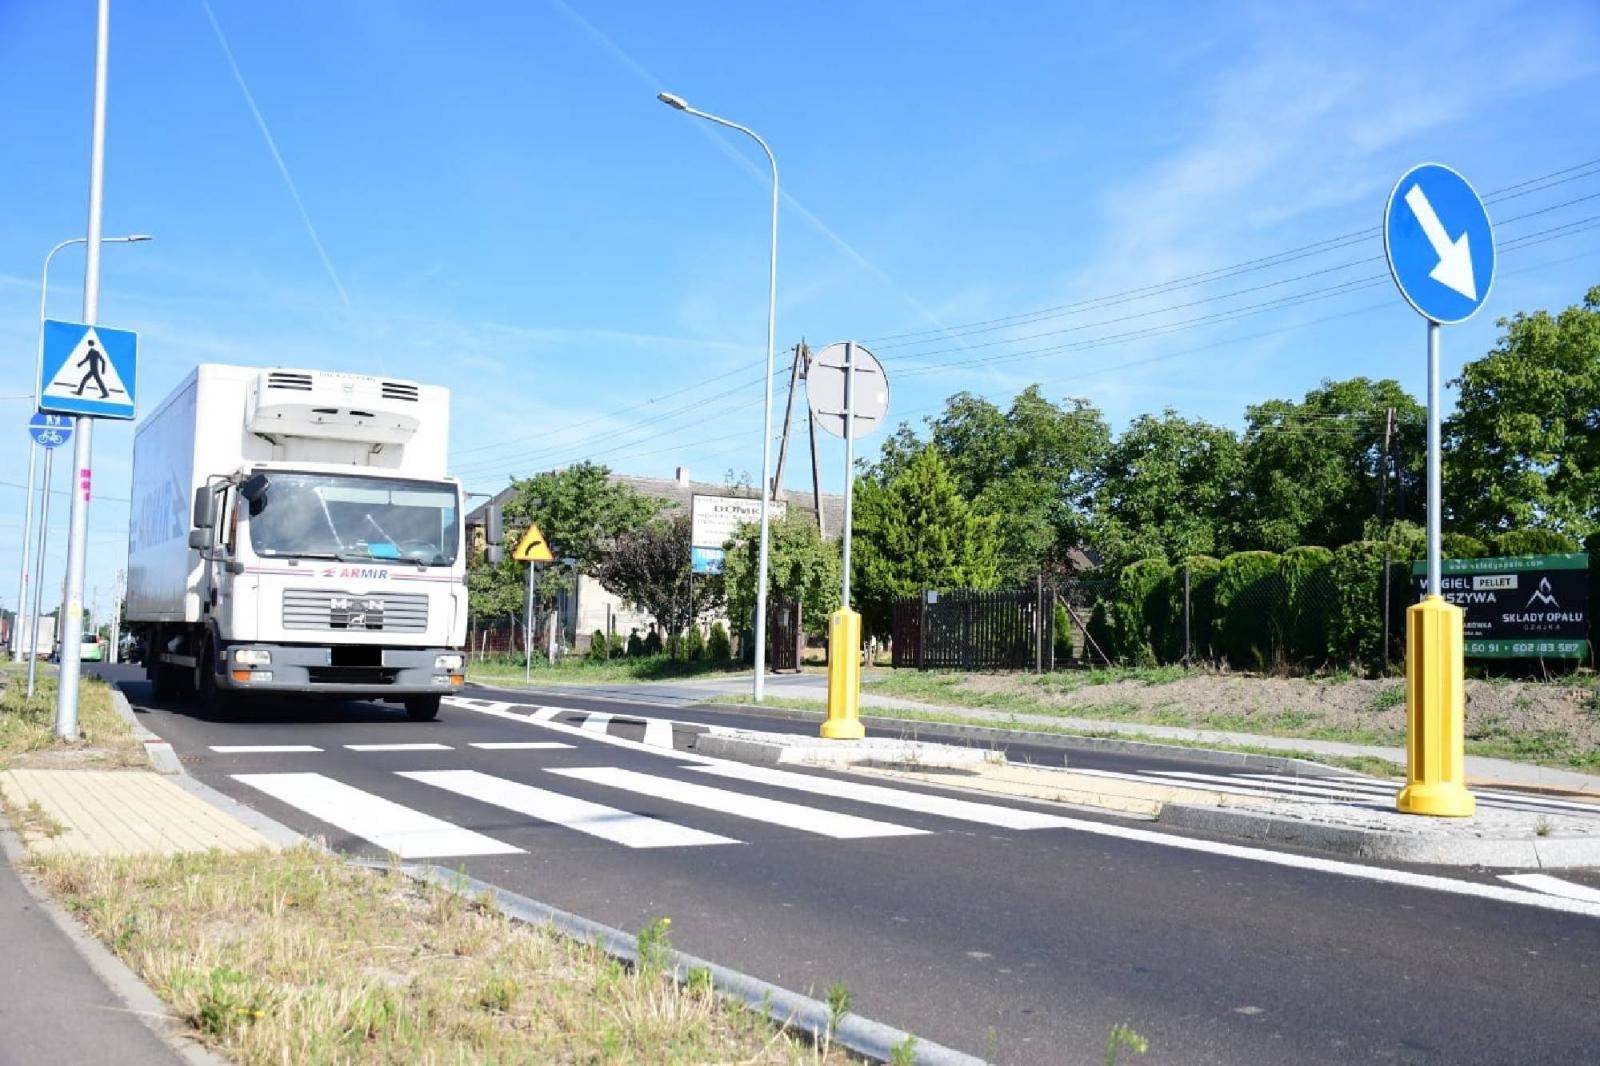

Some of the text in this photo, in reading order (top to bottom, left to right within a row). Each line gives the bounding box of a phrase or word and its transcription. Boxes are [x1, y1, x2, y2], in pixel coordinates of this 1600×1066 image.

[340, 568, 389, 580] ARMIR
[1420, 577, 1512, 590] WGIEL PELLET
